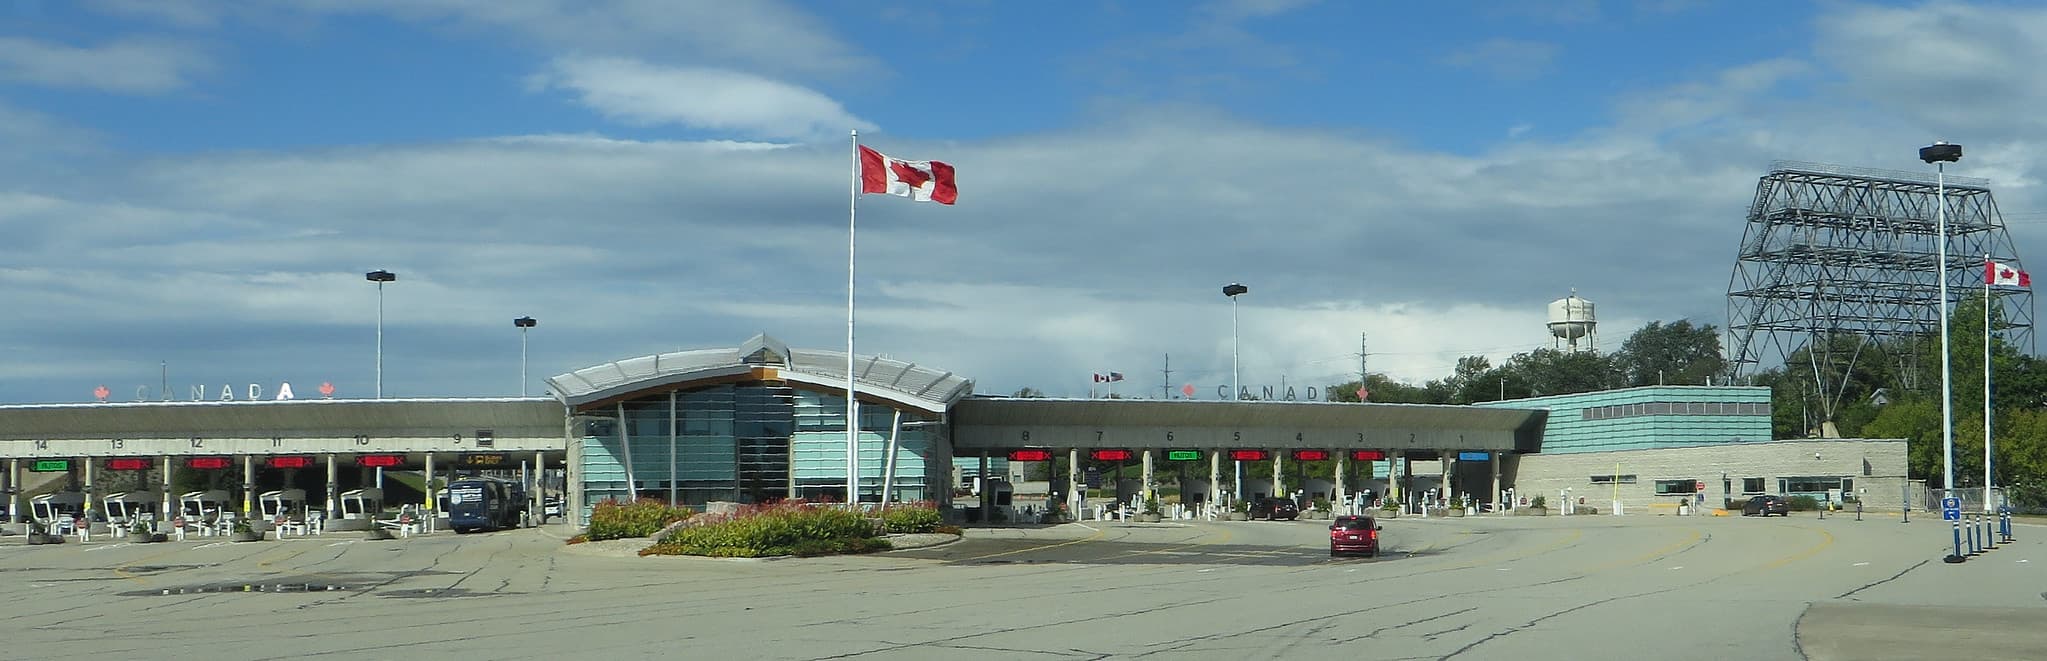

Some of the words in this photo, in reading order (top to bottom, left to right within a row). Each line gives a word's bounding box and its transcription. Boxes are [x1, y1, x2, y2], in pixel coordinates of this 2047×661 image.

[136, 382, 294, 401] CANADA
[1218, 384, 1337, 402] CANAD
[354, 435, 369, 446] 10
[453, 434, 462, 444] 9
[1022, 431, 1030, 441] 8
[1096, 431, 1103, 441] 7
[1167, 431, 1174, 441] 6
[1234, 431, 1240, 441] 5
[1296, 431, 1303, 441] 4
[1358, 432, 1364, 442] 3
[1410, 433, 1416, 442] 2
[35, 440, 47, 450] 14
[111, 439, 124, 449] 13
[190, 438, 203, 448] 12
[272, 436, 282, 447] 11
